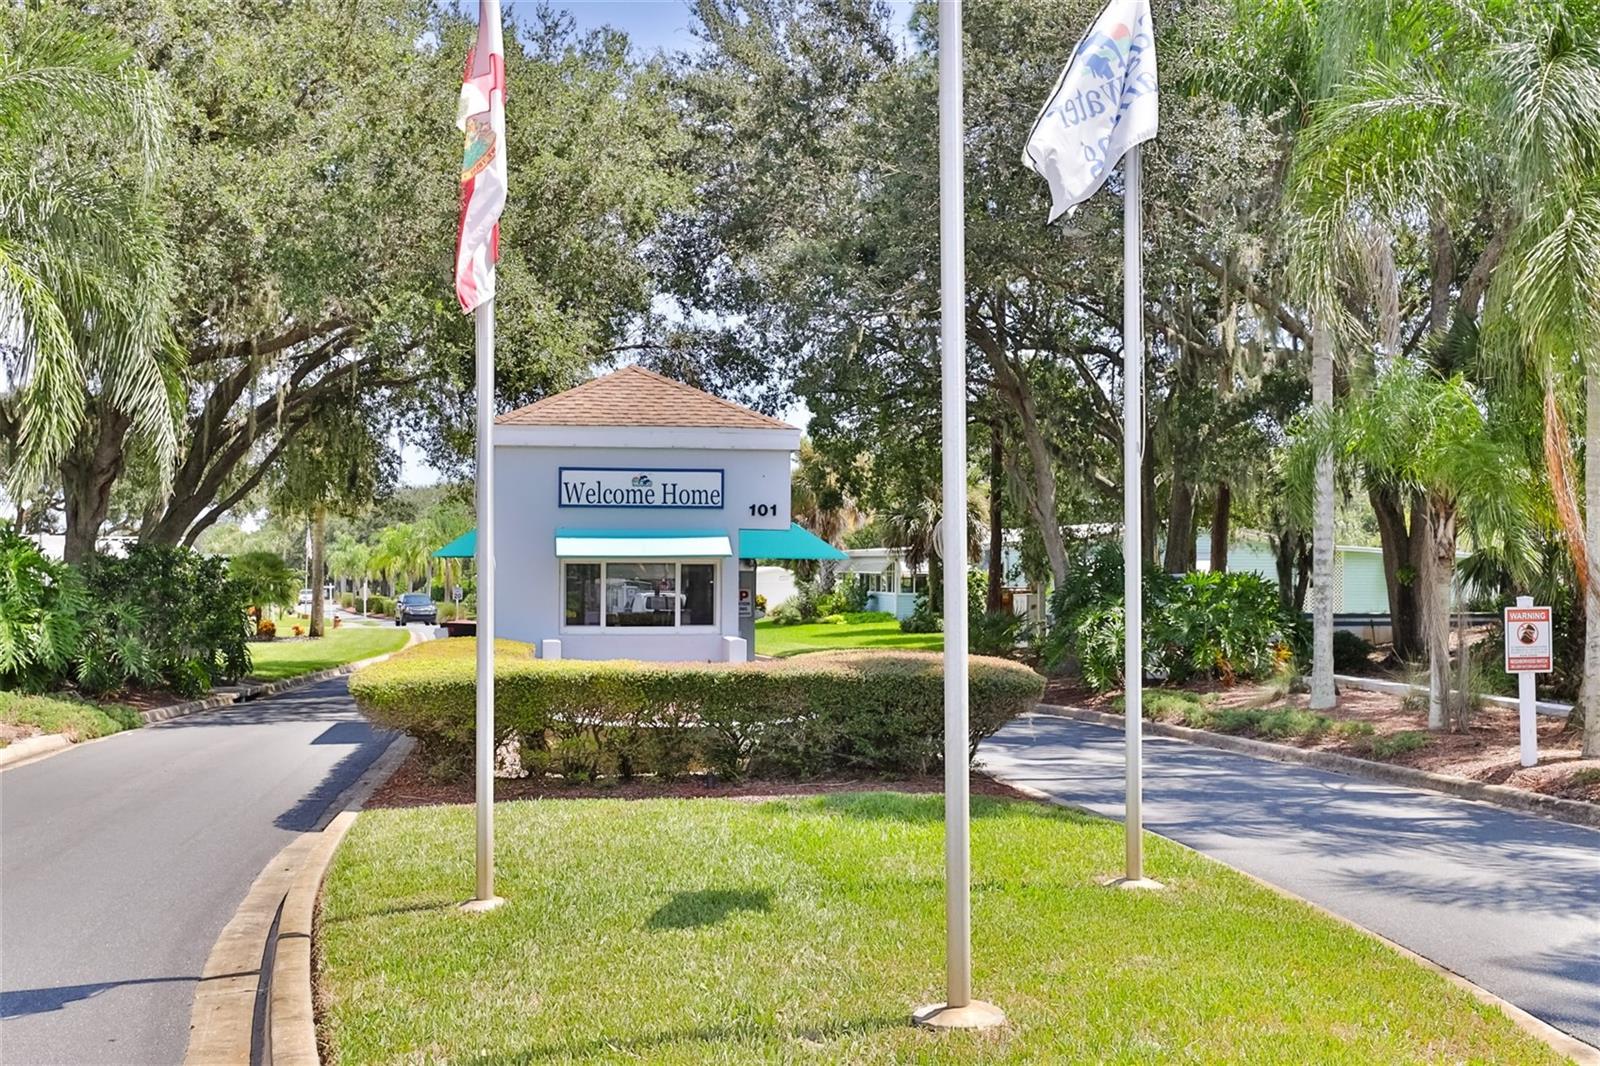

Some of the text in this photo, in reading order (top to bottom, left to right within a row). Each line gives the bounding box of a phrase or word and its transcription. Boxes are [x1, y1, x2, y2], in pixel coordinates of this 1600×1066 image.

[563, 481, 720, 506] Welcome Home
[749, 504, 777, 516] 101
[1509, 612, 1546, 620] WARNING
